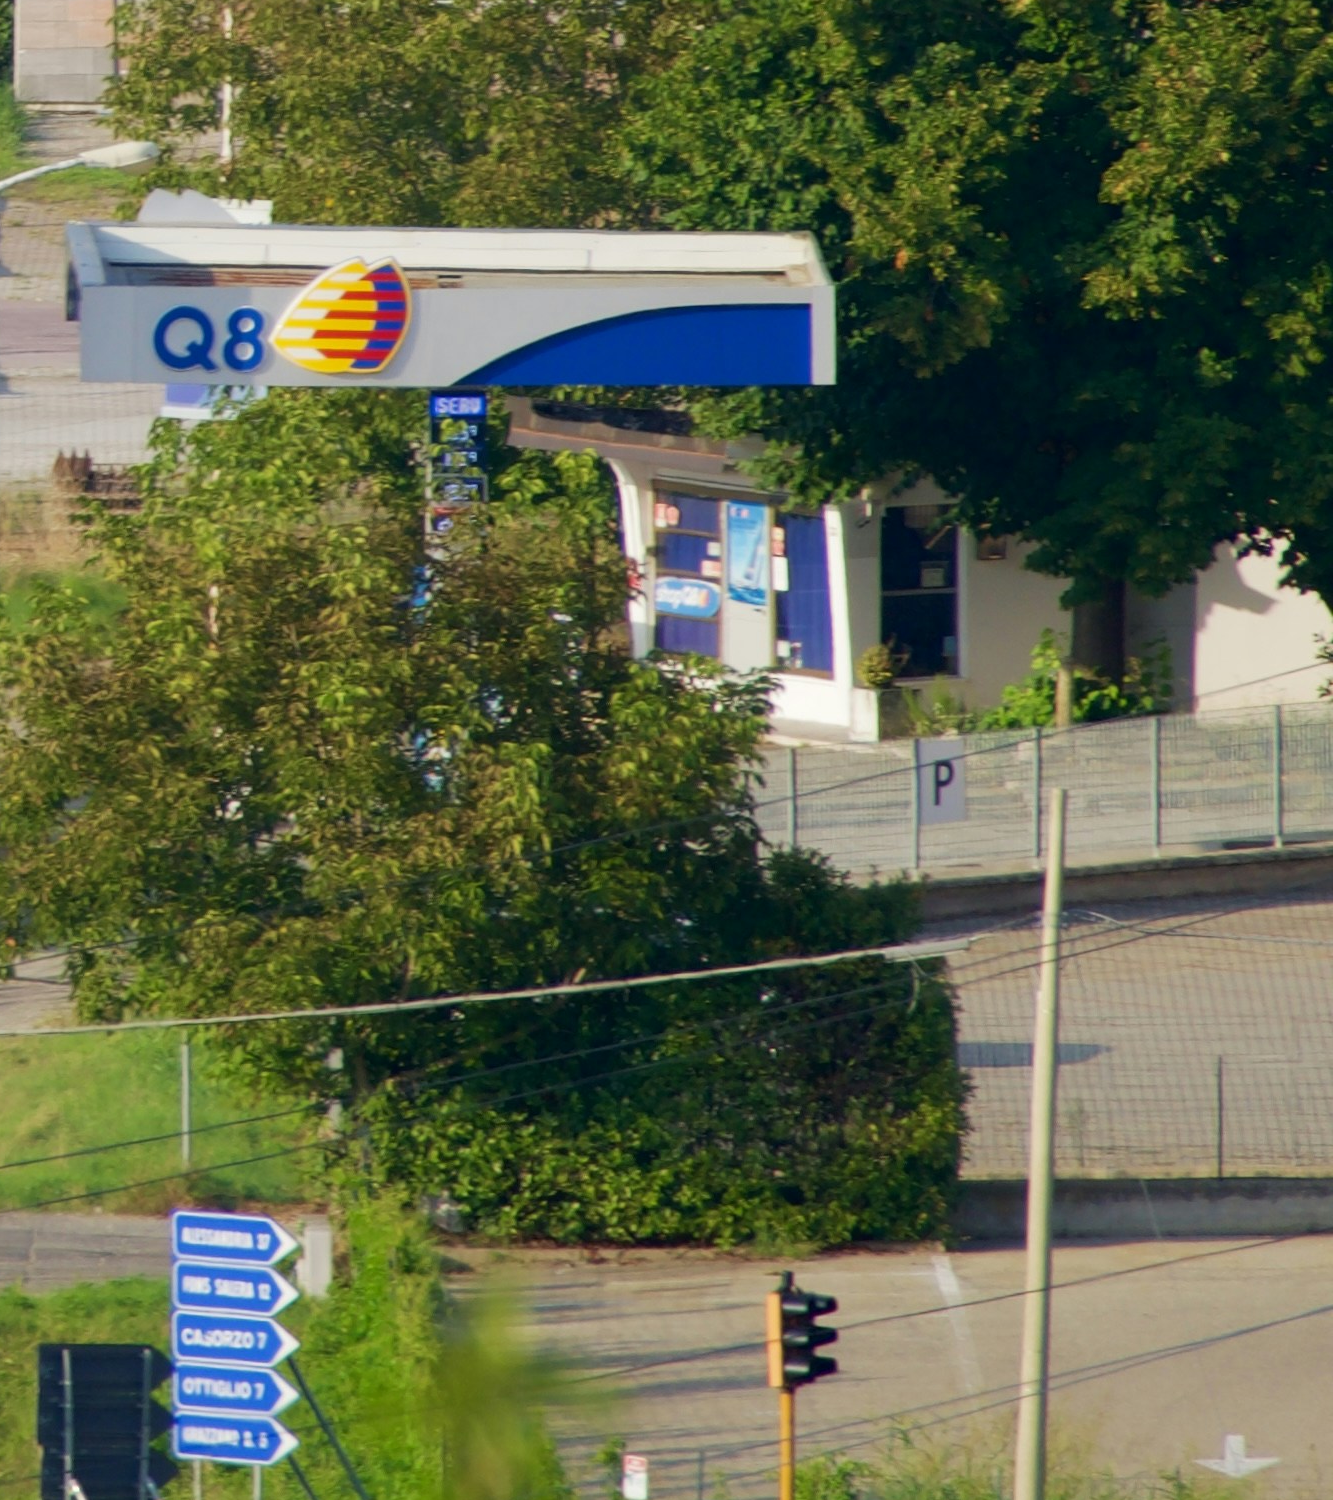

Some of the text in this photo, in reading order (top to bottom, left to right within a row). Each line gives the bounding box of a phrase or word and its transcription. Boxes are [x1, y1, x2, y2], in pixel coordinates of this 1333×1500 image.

[152, 305, 266, 374] Q8
[933, 760, 955, 807] P
[181, 1328, 267, 1349] CASORZO 7
[182, 1377, 265, 1399] OTTIGLIO 7
